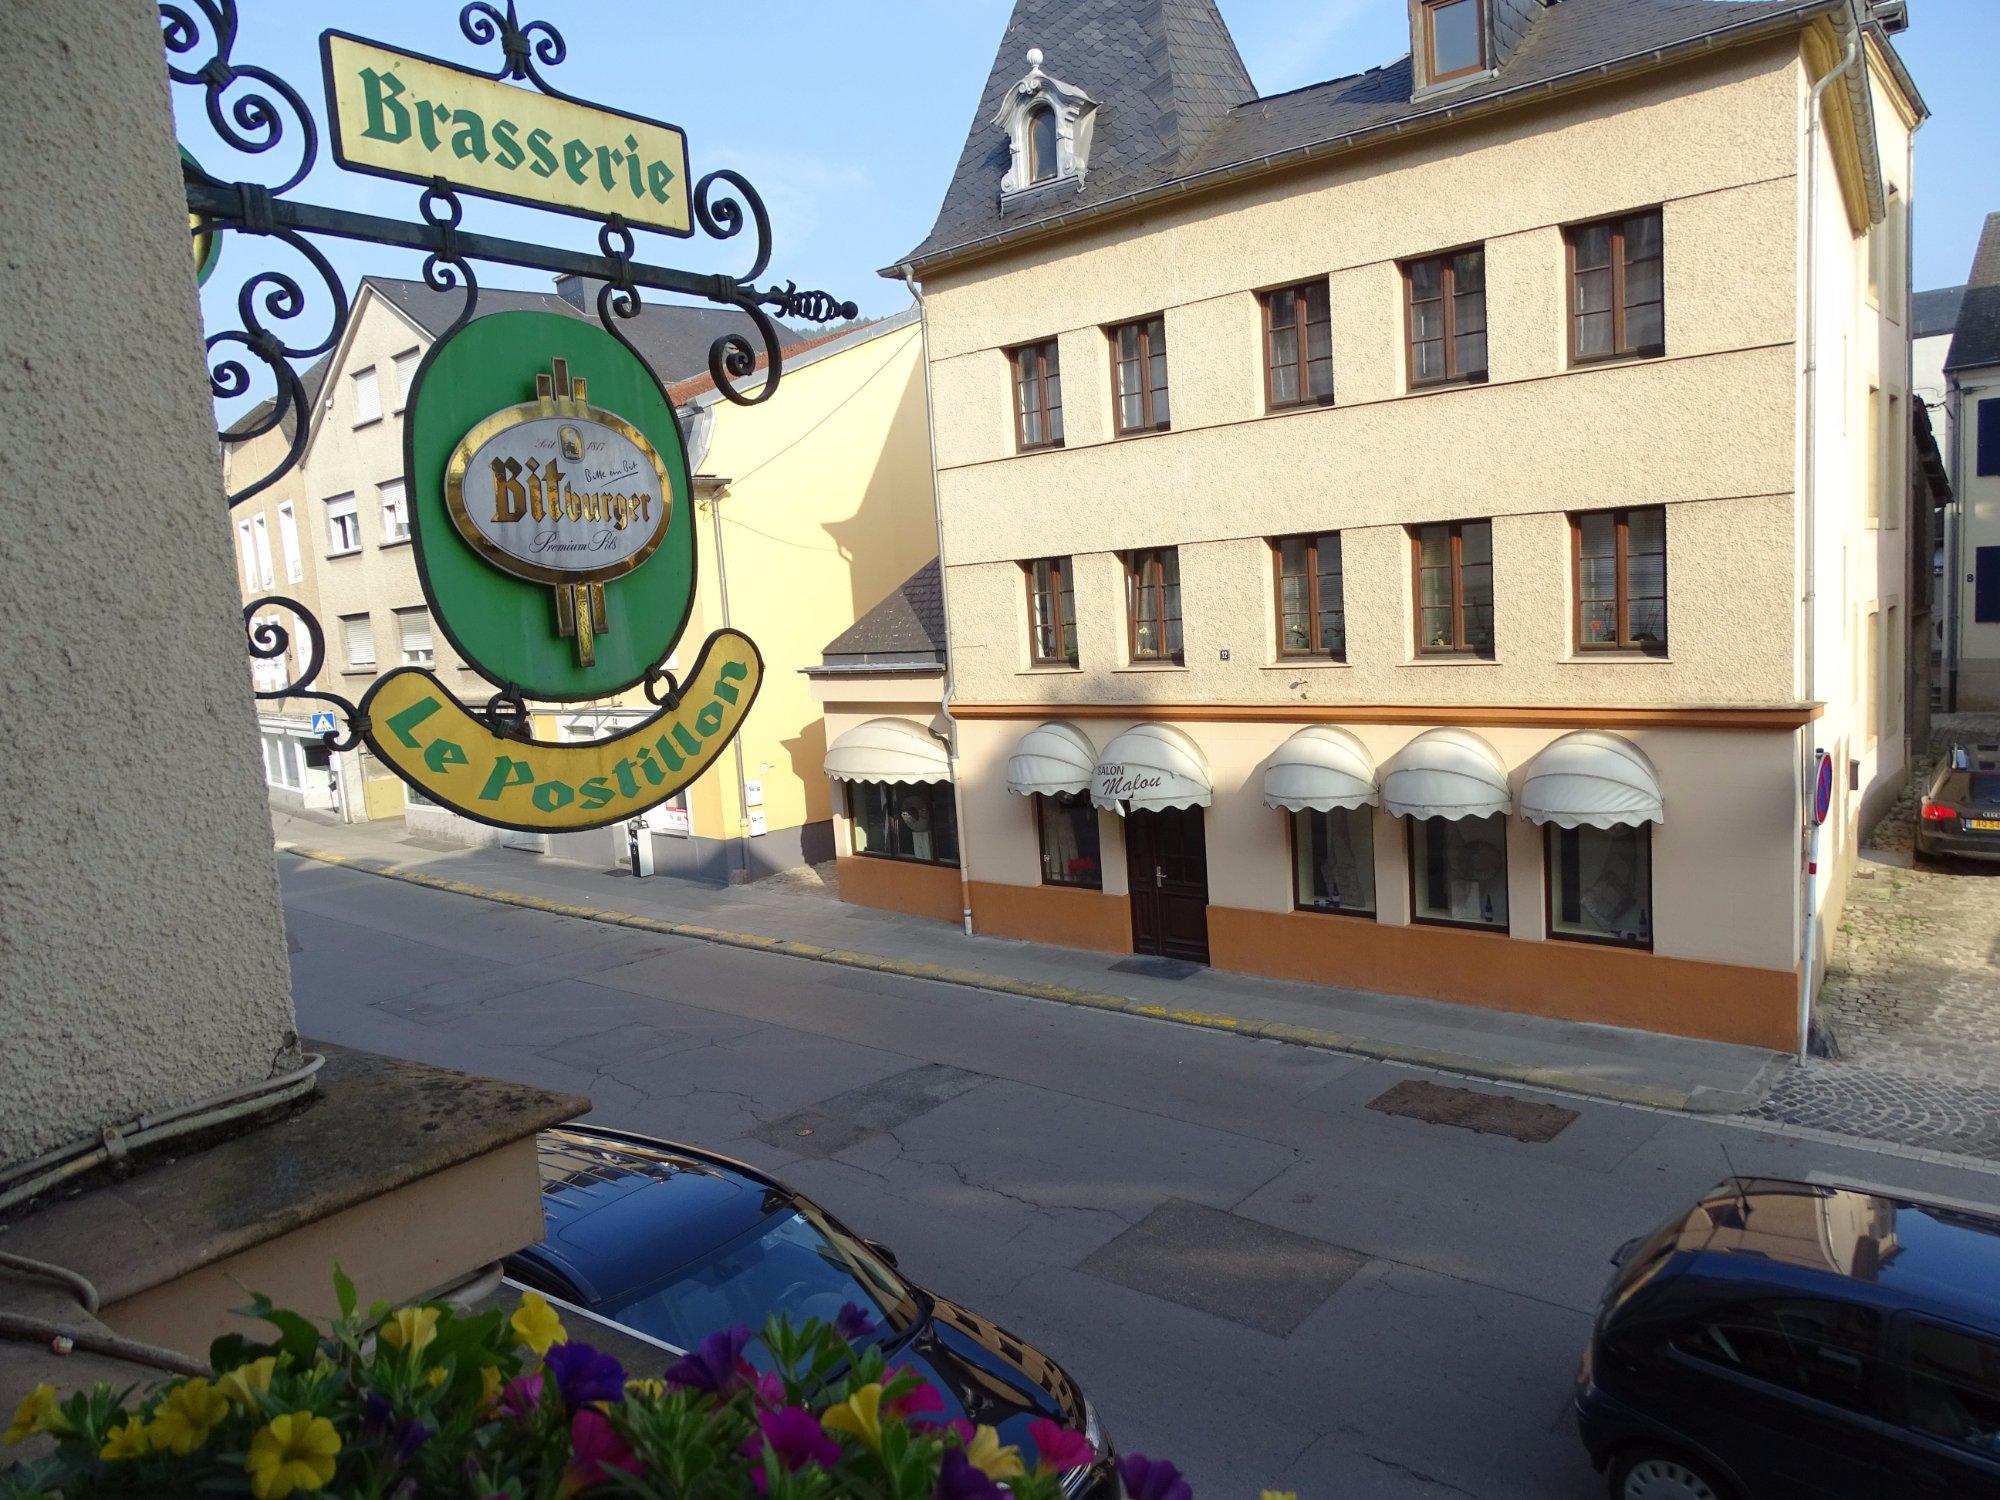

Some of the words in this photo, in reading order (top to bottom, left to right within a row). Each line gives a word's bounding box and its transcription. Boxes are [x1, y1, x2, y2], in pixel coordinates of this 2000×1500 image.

[358, 66, 676, 205] Brasserie
[586, 440, 606, 451] 1817
[584, 468, 608, 483] Bitte
[622, 459, 638, 473] Bit
[488, 456, 652, 531] Bitburger
[528, 529, 588, 553] Premium
[587, 529, 618, 552] Pils
[385, 695, 469, 774] Le
[478, 660, 748, 813] Postillon
[1097, 765, 1125, 776] SALON
[1102, 773, 1162, 796] Malou
